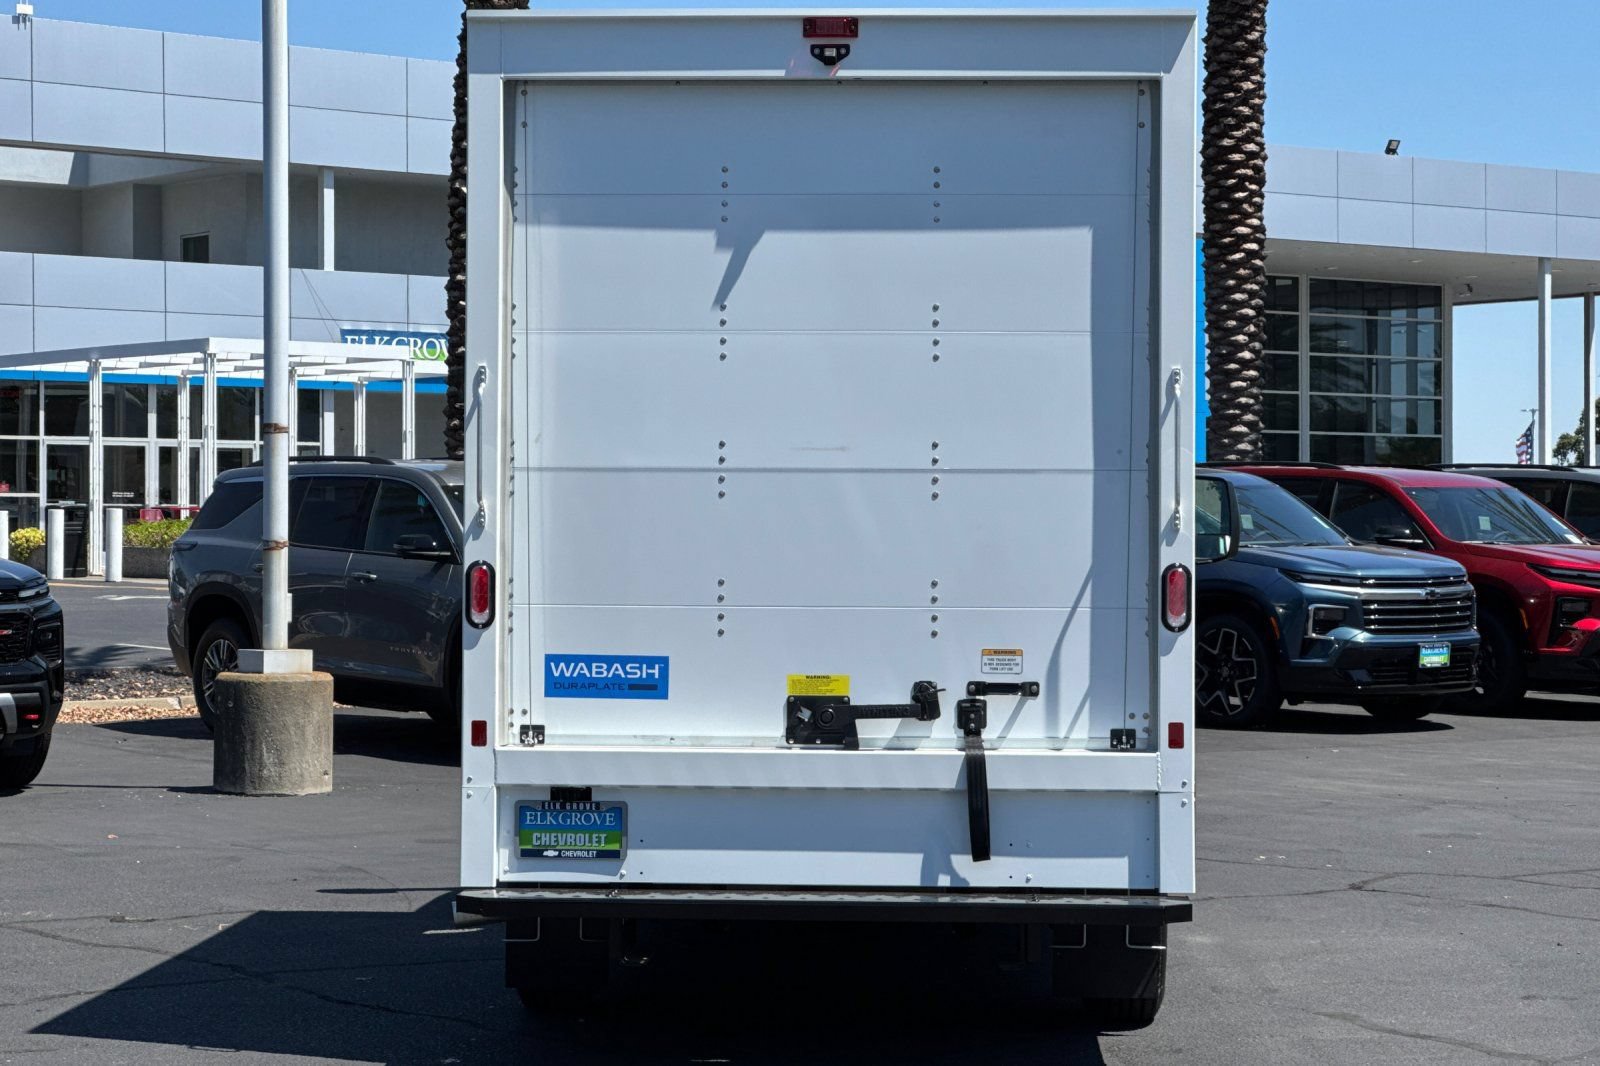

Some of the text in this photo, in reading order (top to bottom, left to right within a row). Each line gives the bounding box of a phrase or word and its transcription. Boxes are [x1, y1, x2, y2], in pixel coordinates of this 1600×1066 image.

[550, 662, 660, 679] WABASH
[553, 682, 626, 691] DURAPLATE
[545, 801, 597, 811] ELK GROVE
[525, 811, 616, 826] ELK GROVE
[532, 832, 608, 847] CHEVROLET
[561, 850, 597, 858] CHEVROLET
